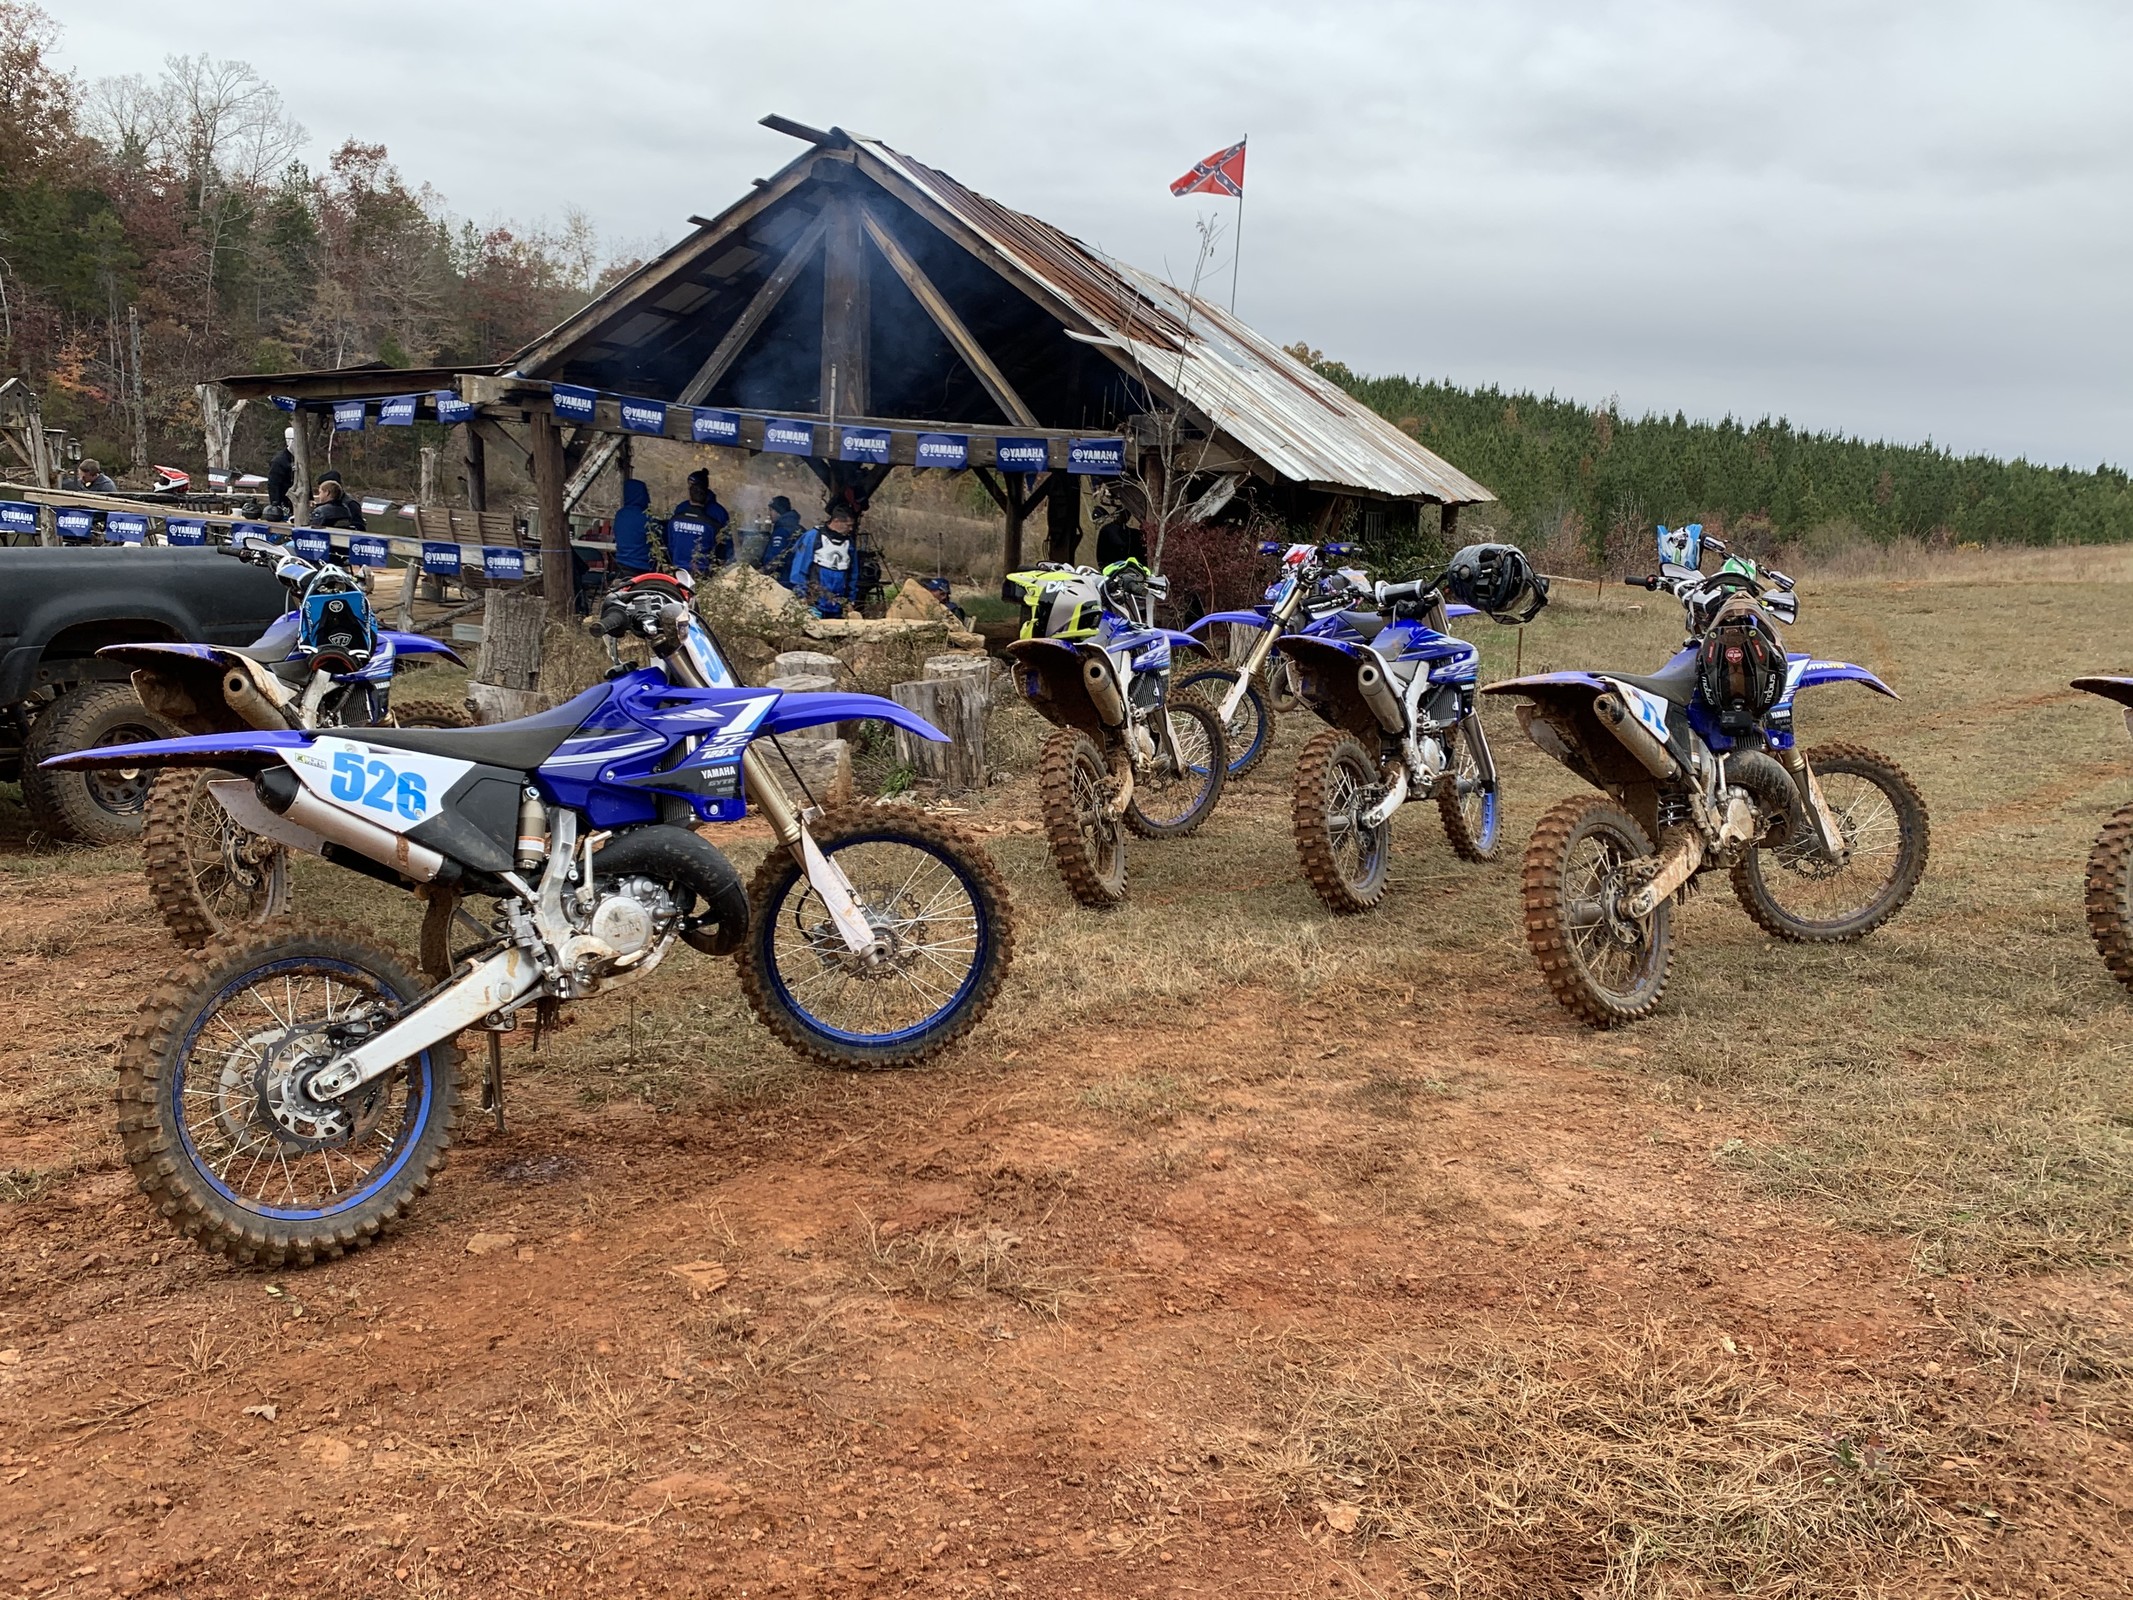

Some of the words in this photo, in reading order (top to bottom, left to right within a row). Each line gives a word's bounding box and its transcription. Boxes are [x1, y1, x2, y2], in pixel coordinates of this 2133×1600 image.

[562, 395, 592, 409] YAMAHA
[340, 409, 362, 418] YAMAHA
[631, 407, 662, 421] YAMAHA
[704, 420, 736, 433] YAMAHA
[777, 430, 809, 442] YAMAHA
[853, 438, 886, 450] YAMAHA
[929, 444, 964, 455] YAMAHA
[1010, 448, 1044, 458] YAMAHA
[1083, 450, 1118, 460] YAMAHA
[8, 511, 34, 521] YAMAHA
[64, 516, 88, 526] YAMAHA
[117, 522, 143, 532] YAMAHA
[177, 525, 201, 535] YAMAHA
[680, 522, 705, 532] YAMAHA
[302, 539, 327, 549] YAMAHA
[360, 545, 385, 555] YAMAHA
[431, 552, 457, 563] YAMAHA
[494, 557, 520, 567] YAMAHA
[1763, 673, 1776, 704] mobius
[701, 766, 736, 779] YAMAHA
[330, 752, 427, 821] 526
